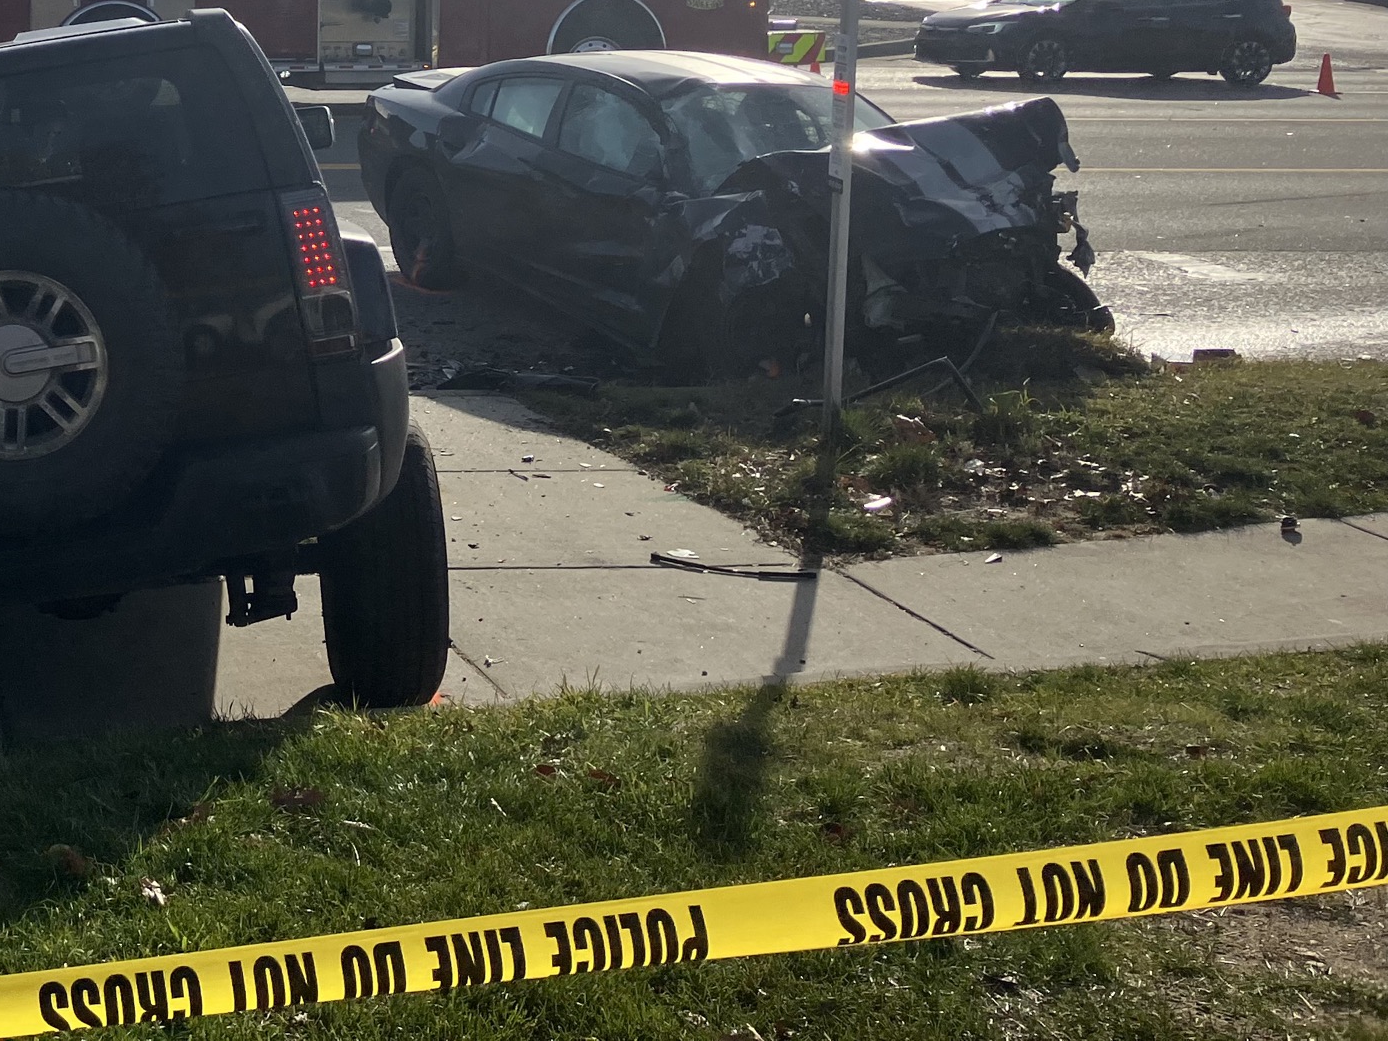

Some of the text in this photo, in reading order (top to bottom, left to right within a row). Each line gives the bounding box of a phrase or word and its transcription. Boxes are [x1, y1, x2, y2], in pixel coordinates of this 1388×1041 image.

[1014, 859, 1106, 926] NOT
[1126, 848, 1190, 912] DO
[1205, 833, 1303, 904] LINE
[833, 872, 995, 946] CROSS
[39, 904, 710, 1032] POLICE LINE DO NOT CROSS
